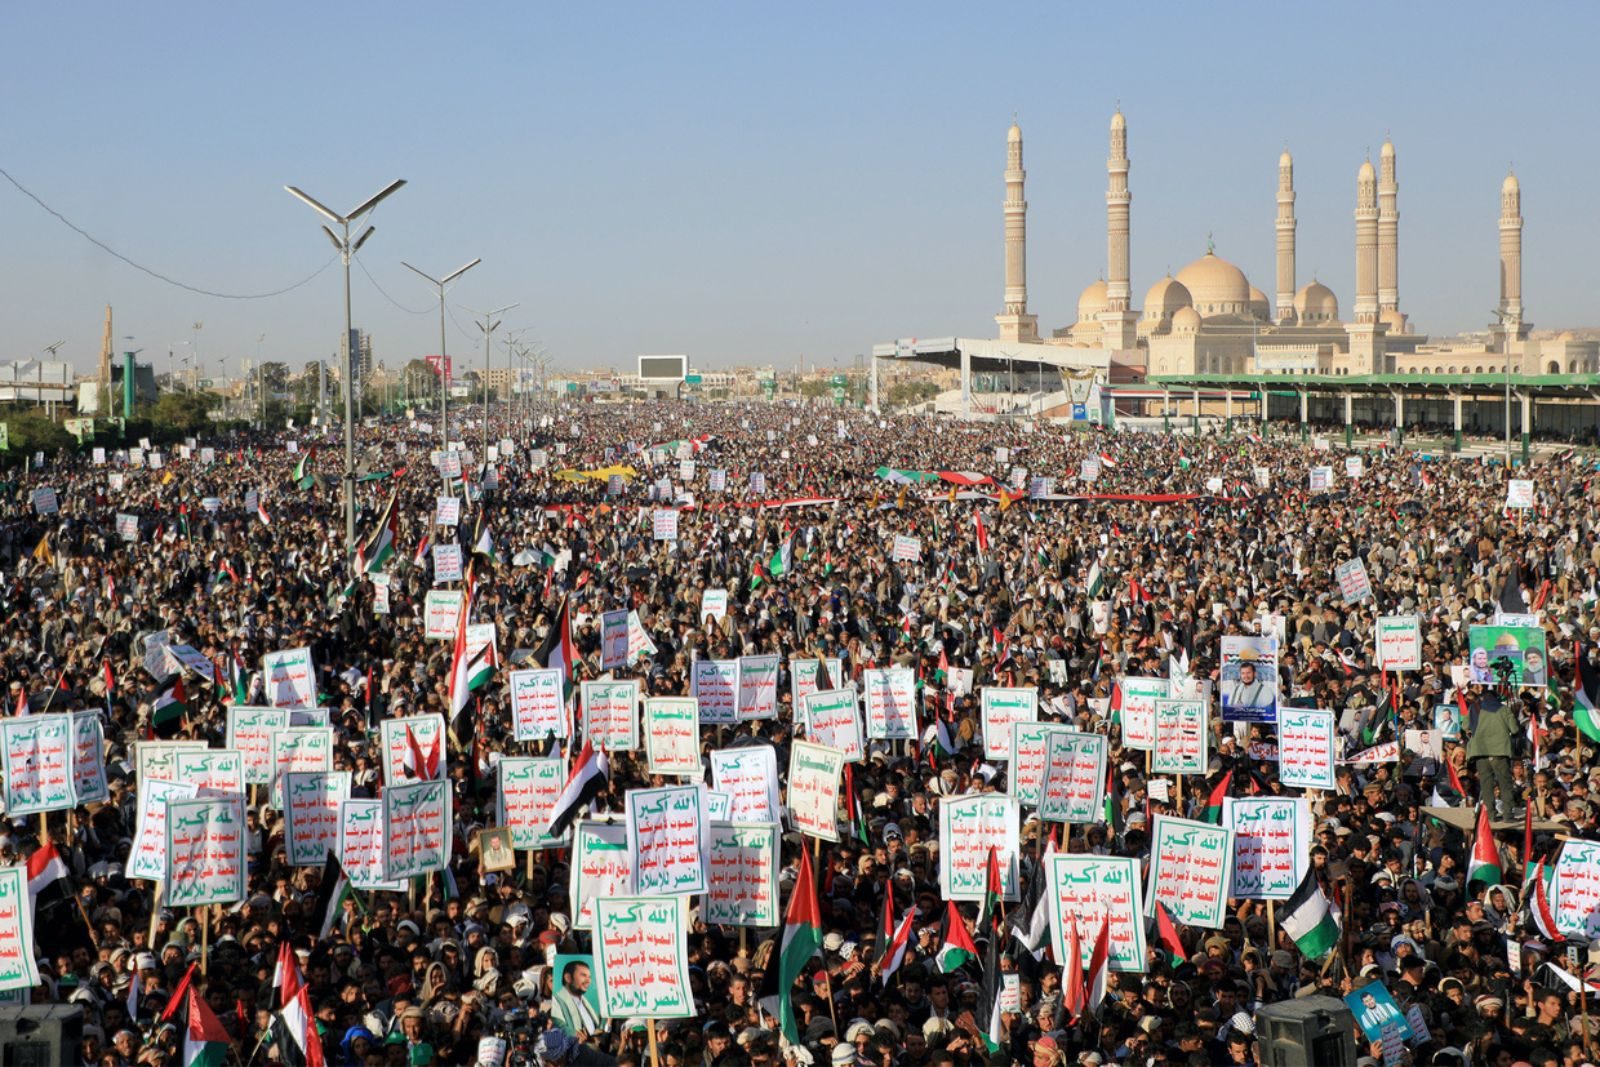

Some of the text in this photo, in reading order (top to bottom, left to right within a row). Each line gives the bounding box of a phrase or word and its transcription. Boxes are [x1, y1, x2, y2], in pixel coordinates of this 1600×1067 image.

[539, 764, 560, 778] الله
[673, 793, 696, 810] الله
[1272, 805, 1292, 820] الله
[671, 816, 697, 831] الموت
[672, 834, 697, 848] الموت
[749, 833, 771, 848] الله
[1268, 828, 1292, 839] الموت
[1200, 833, 1224, 850] الله
[1268, 844, 1292, 856] الموت
[640, 855, 660, 870] اليهود
[663, 853, 675, 867] على
[745, 856, 770, 867] الموت
[1194, 856, 1221, 867] الموت
[1260, 861, 1271, 872] على
[674, 867, 699, 888] النصر
[745, 874, 769, 884] الموت
[1103, 865, 1129, 884] الله
[1192, 873, 1219, 885] الموت
[1267, 873, 1293, 891] النصر
[210, 878, 239, 899] النصر
[736, 888, 746, 900] على
[1157, 886, 1179, 898] اليهود
[1181, 888, 1193, 900] على
[603, 901, 674, 930] الله أكبر
[743, 904, 769, 922] النصر
[1187, 905, 1215, 921] النصر
[647, 932, 675, 945] الموت
[649, 953, 676, 966] الموت
[609, 971, 636, 988] اليهود
[640, 971, 654, 986] على
[653, 987, 684, 1011] النصر
